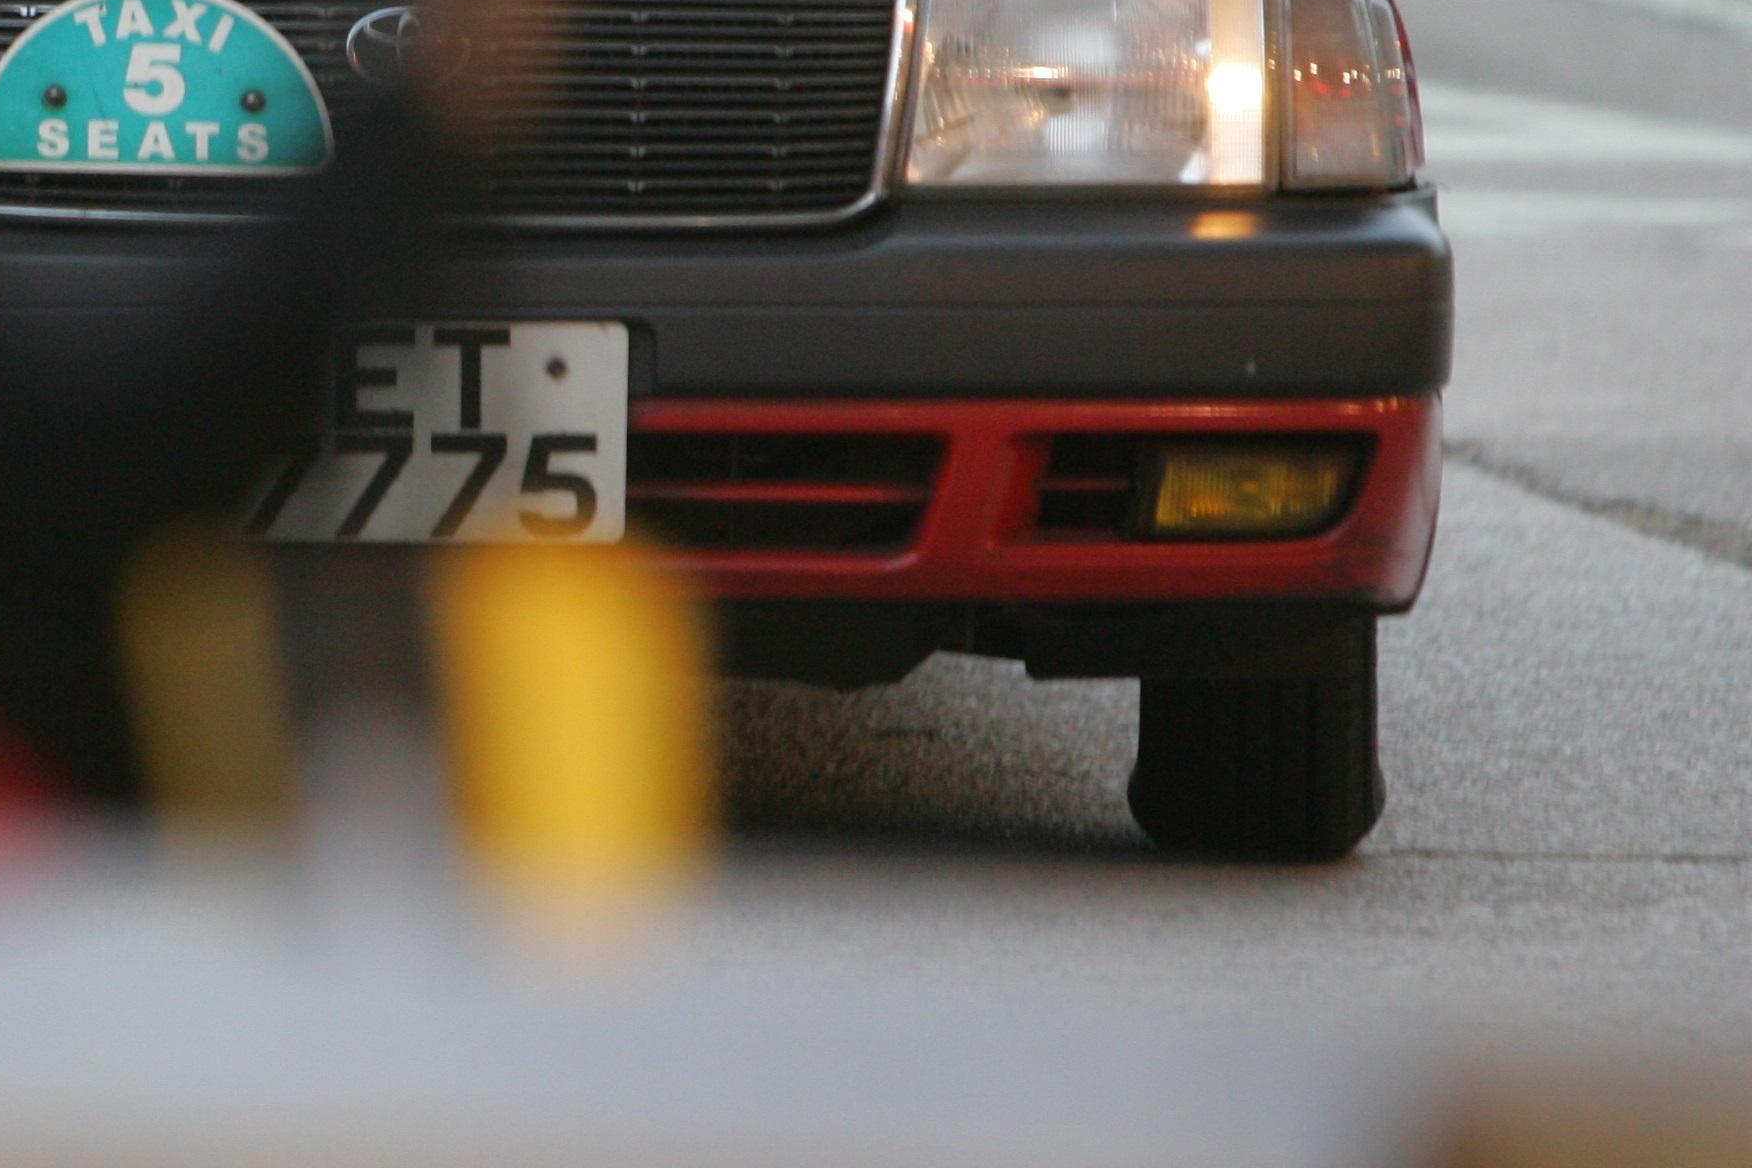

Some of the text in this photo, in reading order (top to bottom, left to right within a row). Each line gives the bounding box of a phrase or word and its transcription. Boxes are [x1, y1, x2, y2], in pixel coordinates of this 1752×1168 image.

[123, 44, 186, 116] 5
[37, 119, 269, 161] SEATS
[336, 327, 511, 430] ET
